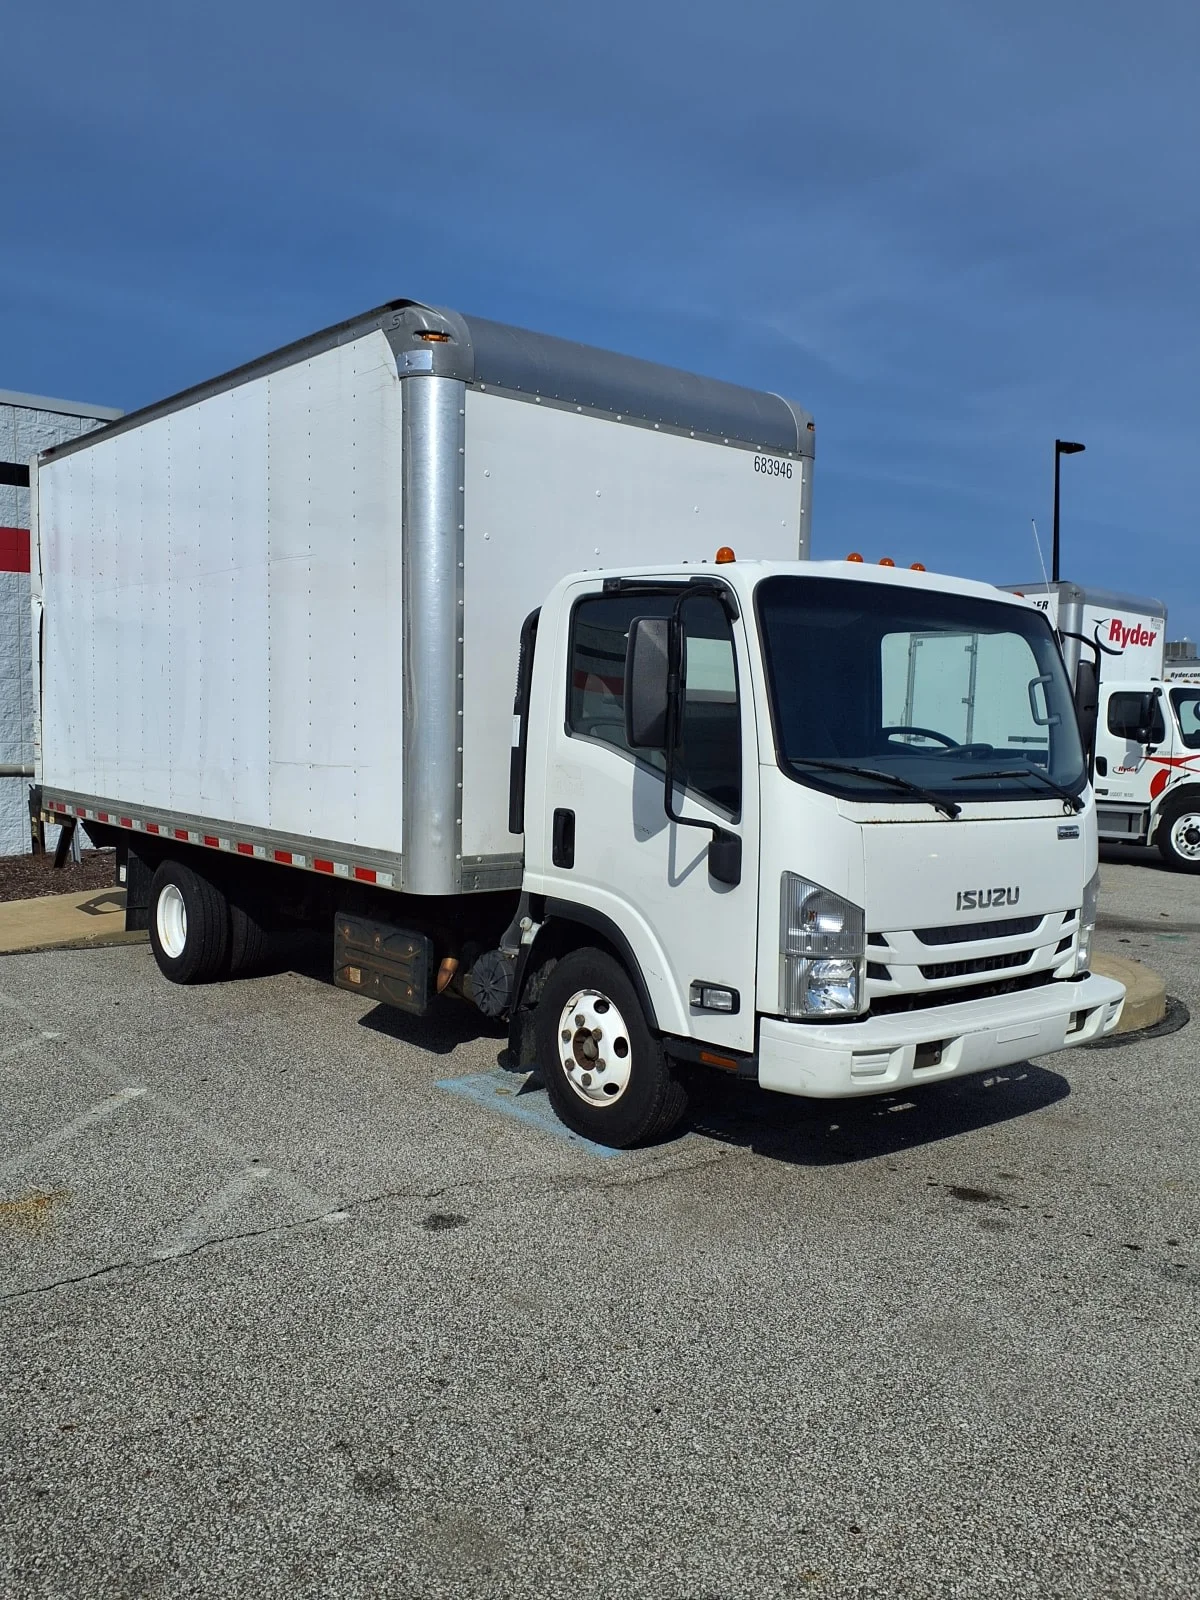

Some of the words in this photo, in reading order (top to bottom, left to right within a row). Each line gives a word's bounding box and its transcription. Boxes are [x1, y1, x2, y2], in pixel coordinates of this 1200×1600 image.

[754, 455, 793, 479] 683946
[1033, 600, 1049, 610] ER
[1109, 618, 1157, 648] Ryder
[956, 886, 1020, 911] ISUZU
